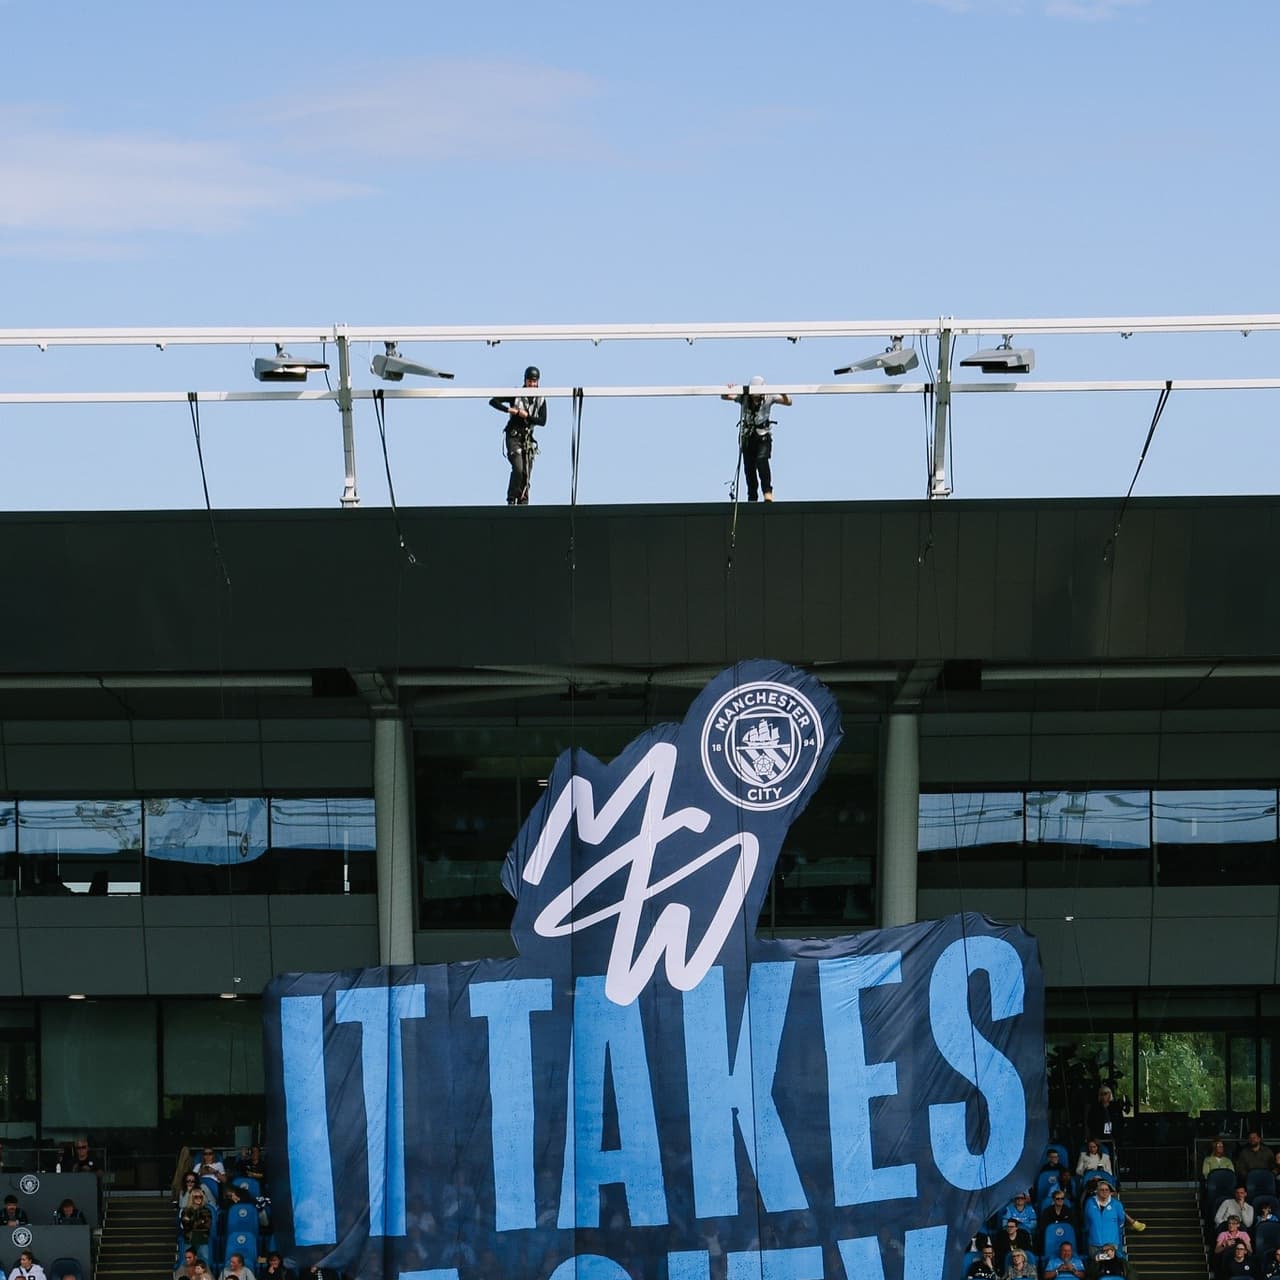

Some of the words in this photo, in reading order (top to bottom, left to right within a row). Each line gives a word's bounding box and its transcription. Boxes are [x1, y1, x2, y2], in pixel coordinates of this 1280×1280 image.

[715, 692, 810, 731] MANCHESTER
[747, 787, 782, 800] CITY
[281, 983, 425, 1246] IT
[469, 935, 1026, 1231] TAKES
